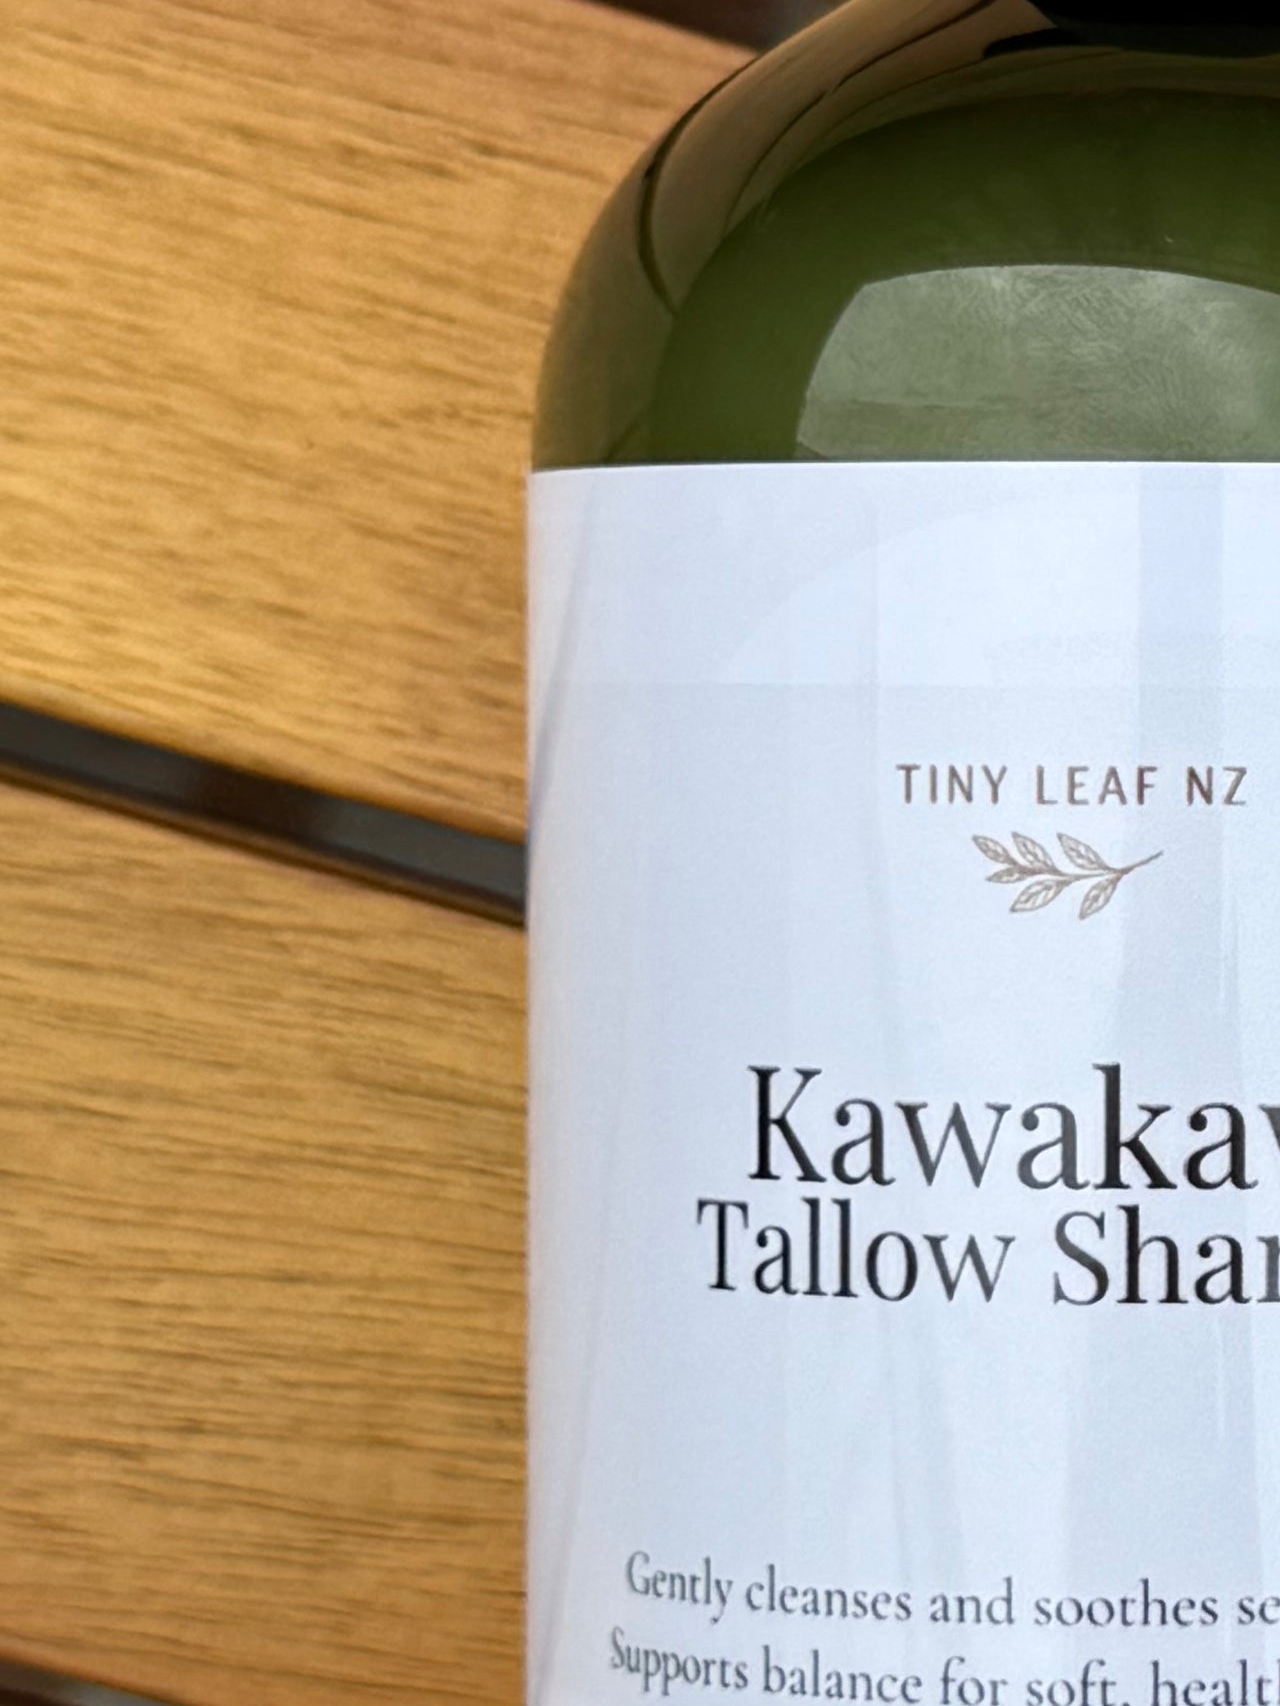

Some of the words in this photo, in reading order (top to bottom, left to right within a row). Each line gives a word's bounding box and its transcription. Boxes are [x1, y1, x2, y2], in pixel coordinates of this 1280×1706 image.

[894, 762, 1009, 806] TINY
[1035, 764, 1159, 807] LEAF
[1185, 765, 1248, 807] NZ
[696, 1196, 1016, 1304] Tallow
[624, 1550, 735, 1626] Gently
[744, 1562, 914, 1623] cleanses
[928, 1575, 1016, 1627] and
[1033, 1576, 1220, 1628] soothes
[610, 1626, 750, 1698] Supports
[761, 1643, 924, 1706] balance
